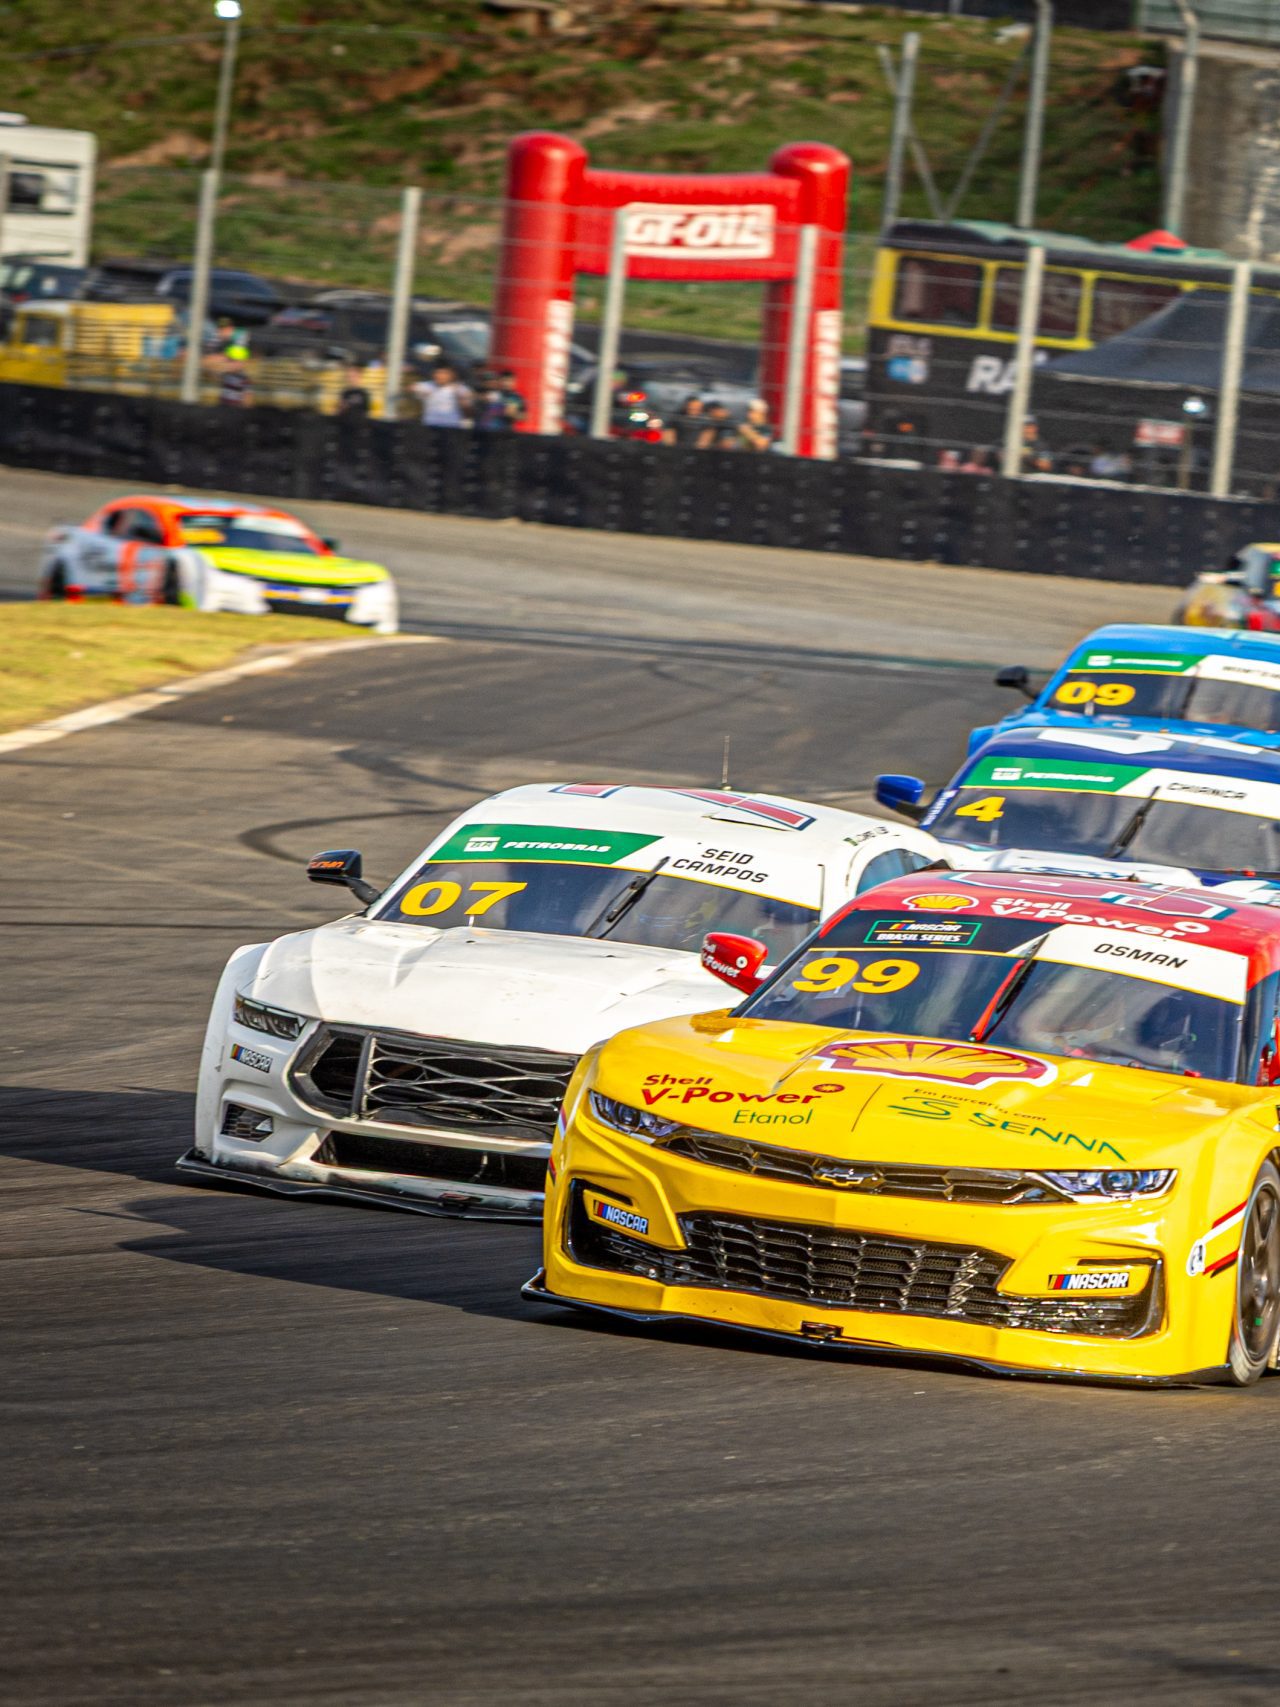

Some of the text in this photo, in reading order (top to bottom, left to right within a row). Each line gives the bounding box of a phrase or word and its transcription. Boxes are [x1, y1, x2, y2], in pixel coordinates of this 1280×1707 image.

[1056, 681, 1136, 706] 09
[955, 797, 1005, 822] 4
[502, 841, 612, 853] PETROBRAS
[701, 848, 755, 865] SEID
[672, 858, 769, 883] CAMPOS
[400, 880, 528, 916] 07
[992, 897, 1073, 911] Shell
[906, 923, 963, 932] NASCAR
[990, 904, 1187, 939] V-Power
[876, 933, 962, 942] BRASIL SERIES
[1093, 942, 1189, 969] OSMAN
[791, 957, 921, 995] 99
[241, 1048, 272, 1073] NASCAR
[643, 1074, 714, 1086] Shell
[641, 1086, 822, 1106] V-Power
[913, 1087, 937, 1097] Em
[1014, 1112, 1047, 1122] com
[732, 1108, 814, 1125] Etanol
[968, 1111, 1128, 1163] SENNA
[605, 1205, 648, 1234] NASCAR
[1067, 1272, 1129, 1290] NASCAR
